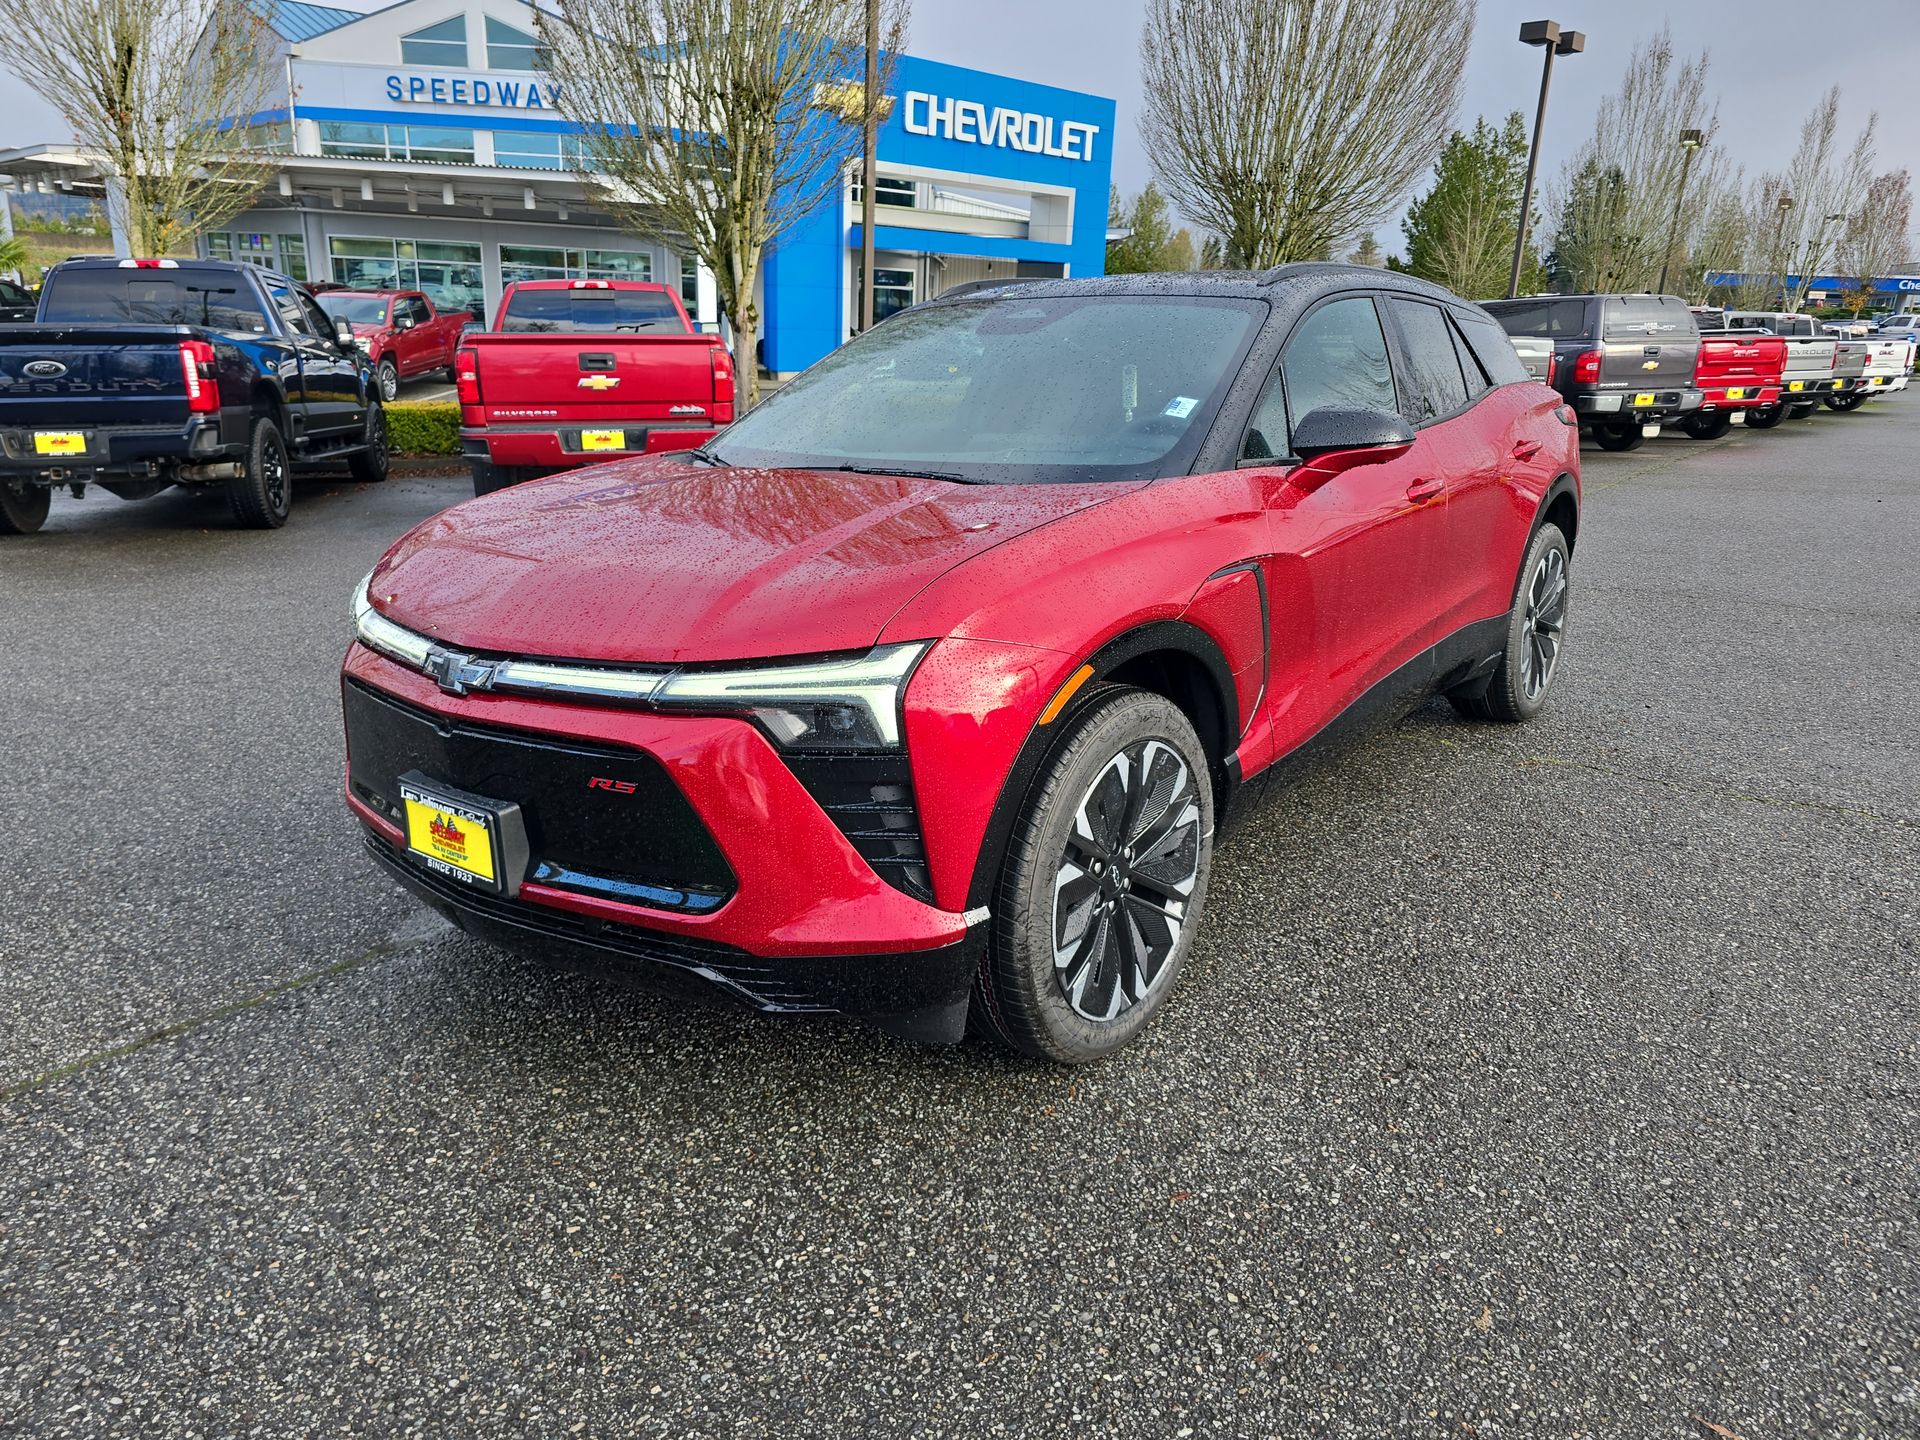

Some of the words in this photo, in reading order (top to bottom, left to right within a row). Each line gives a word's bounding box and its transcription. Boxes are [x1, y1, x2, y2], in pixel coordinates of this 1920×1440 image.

[386, 75, 562, 109] SPEEDWAY
[904, 90, 1100, 162] CHEVROLET
[34, 364, 56, 373] Ford
[68, 382, 168, 392] DUTY
[587, 776, 638, 794] RS
[427, 858, 451, 875] SINCE
[453, 866, 473, 884] 1933
